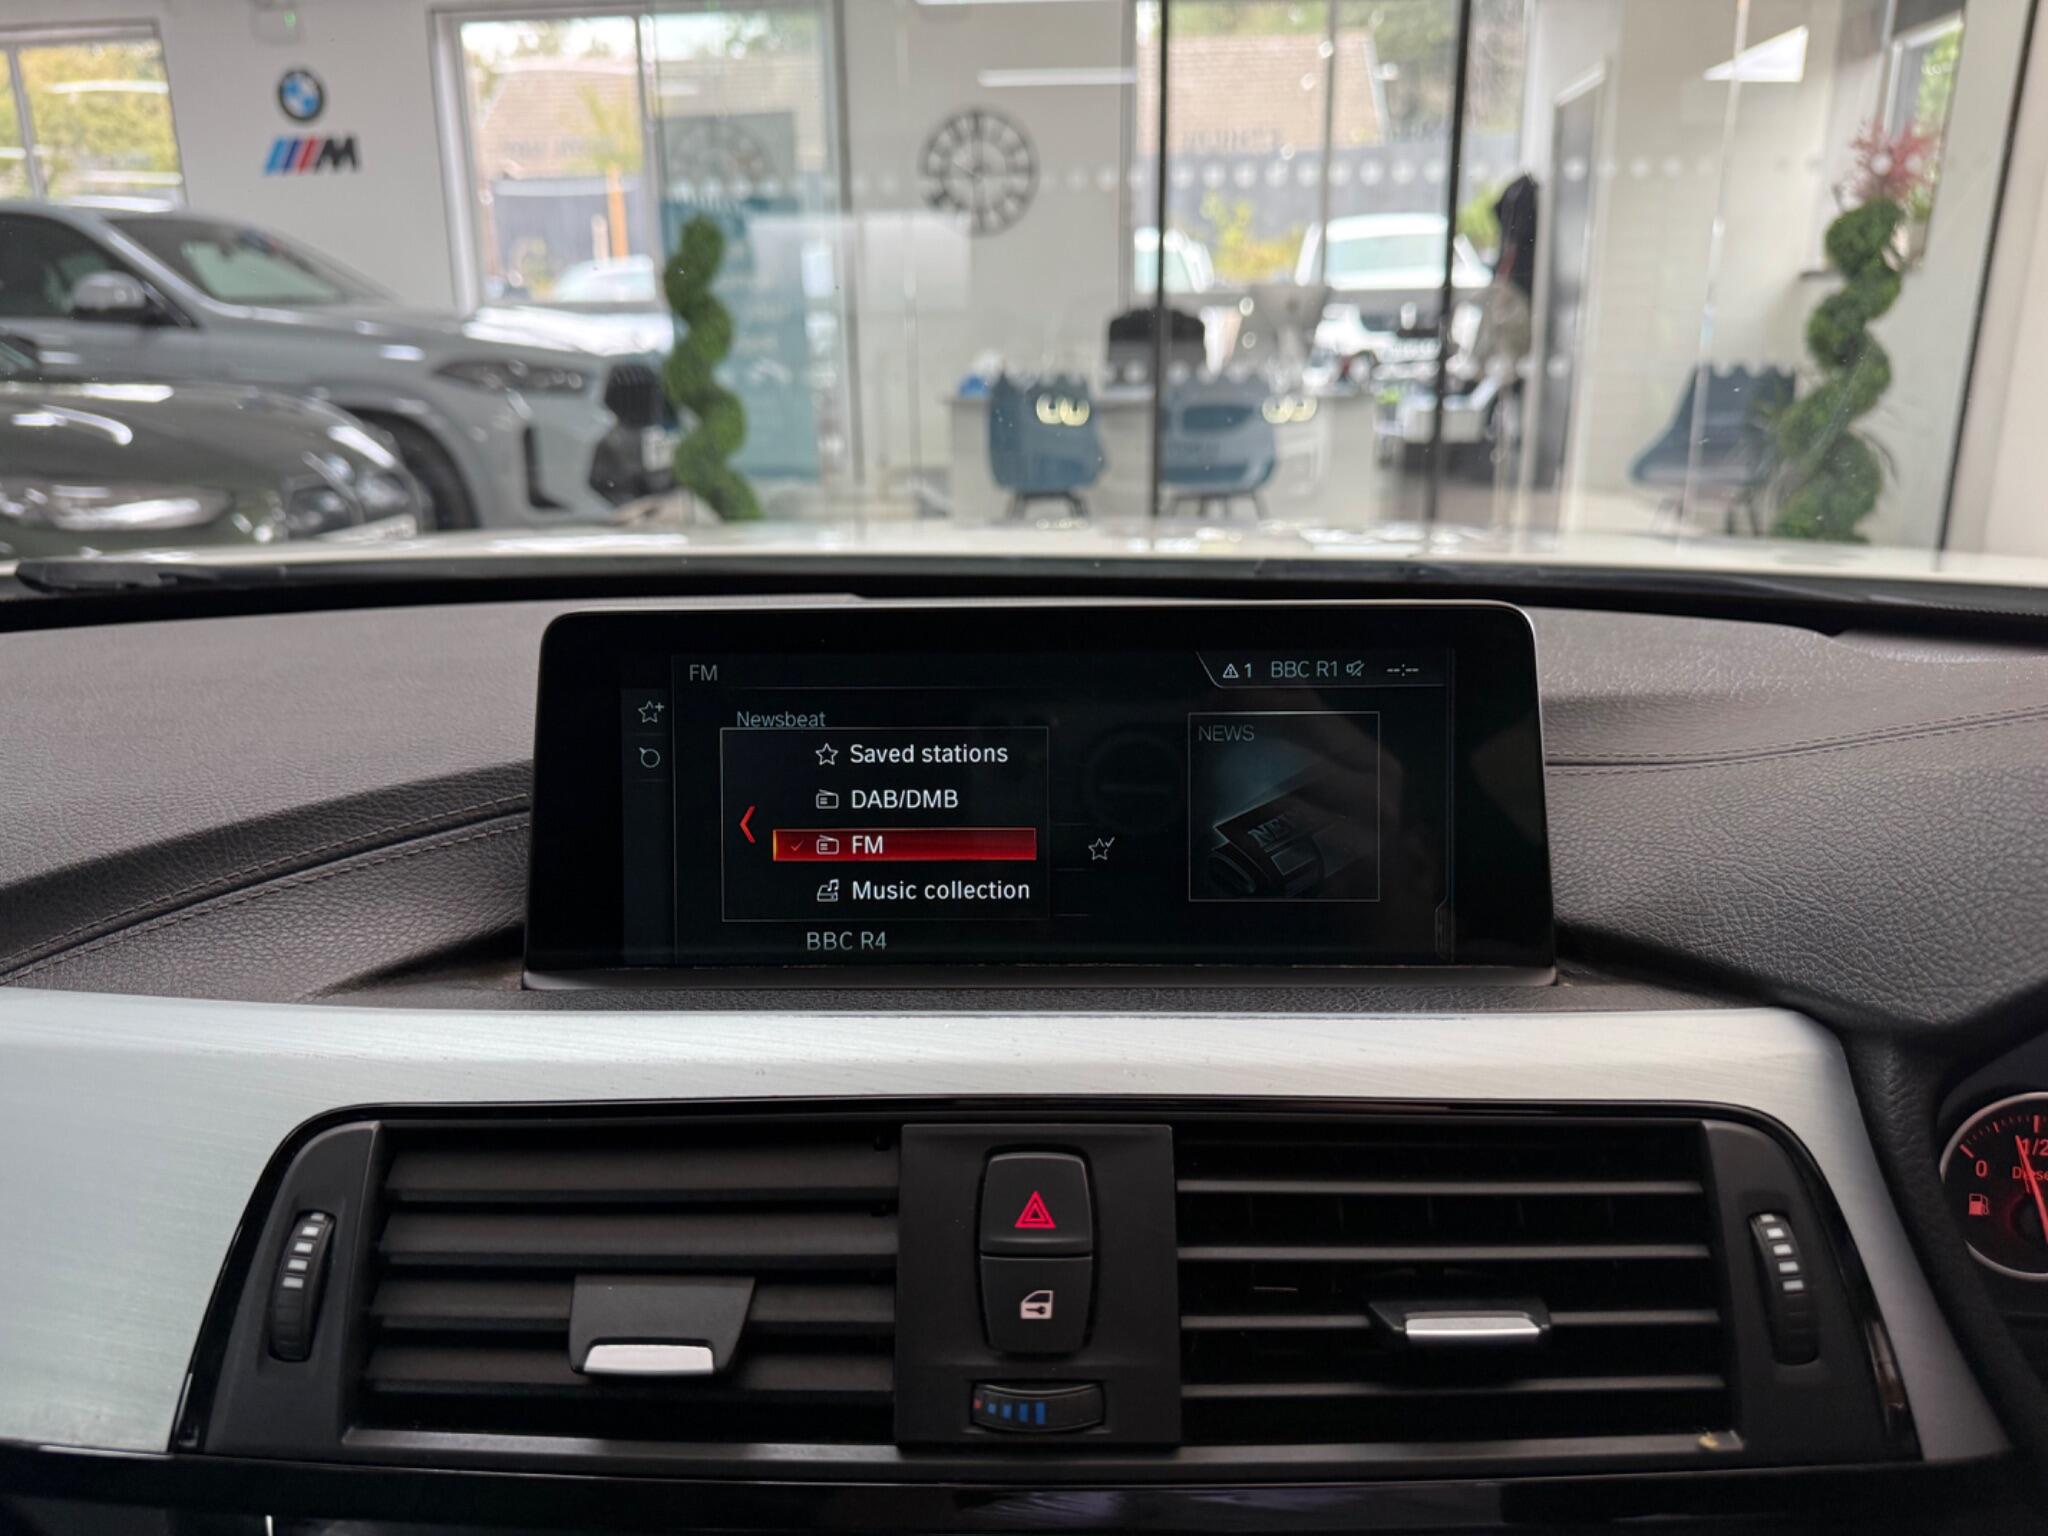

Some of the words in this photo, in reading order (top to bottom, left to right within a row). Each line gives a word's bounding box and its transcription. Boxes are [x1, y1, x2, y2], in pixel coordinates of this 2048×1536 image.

[689, 664, 718, 681] FM
[1244, 662, 1253, 678] 1
[1270, 660, 1310, 679] BBC
[1316, 660, 1339, 678] R1
[736, 711, 826, 728] Newsbeat
[1198, 725, 1256, 742] NEWS
[849, 744, 915, 764] Saved
[921, 744, 1009, 763] stations
[850, 789, 959, 810] DAB/DMB
[851, 835, 884, 855] FM
[851, 881, 918, 900] Music
[924, 880, 1031, 901] collection
[806, 931, 853, 951] BBC
[860, 931, 888, 950] R4
[1975, 1159, 1988, 1178] 0
